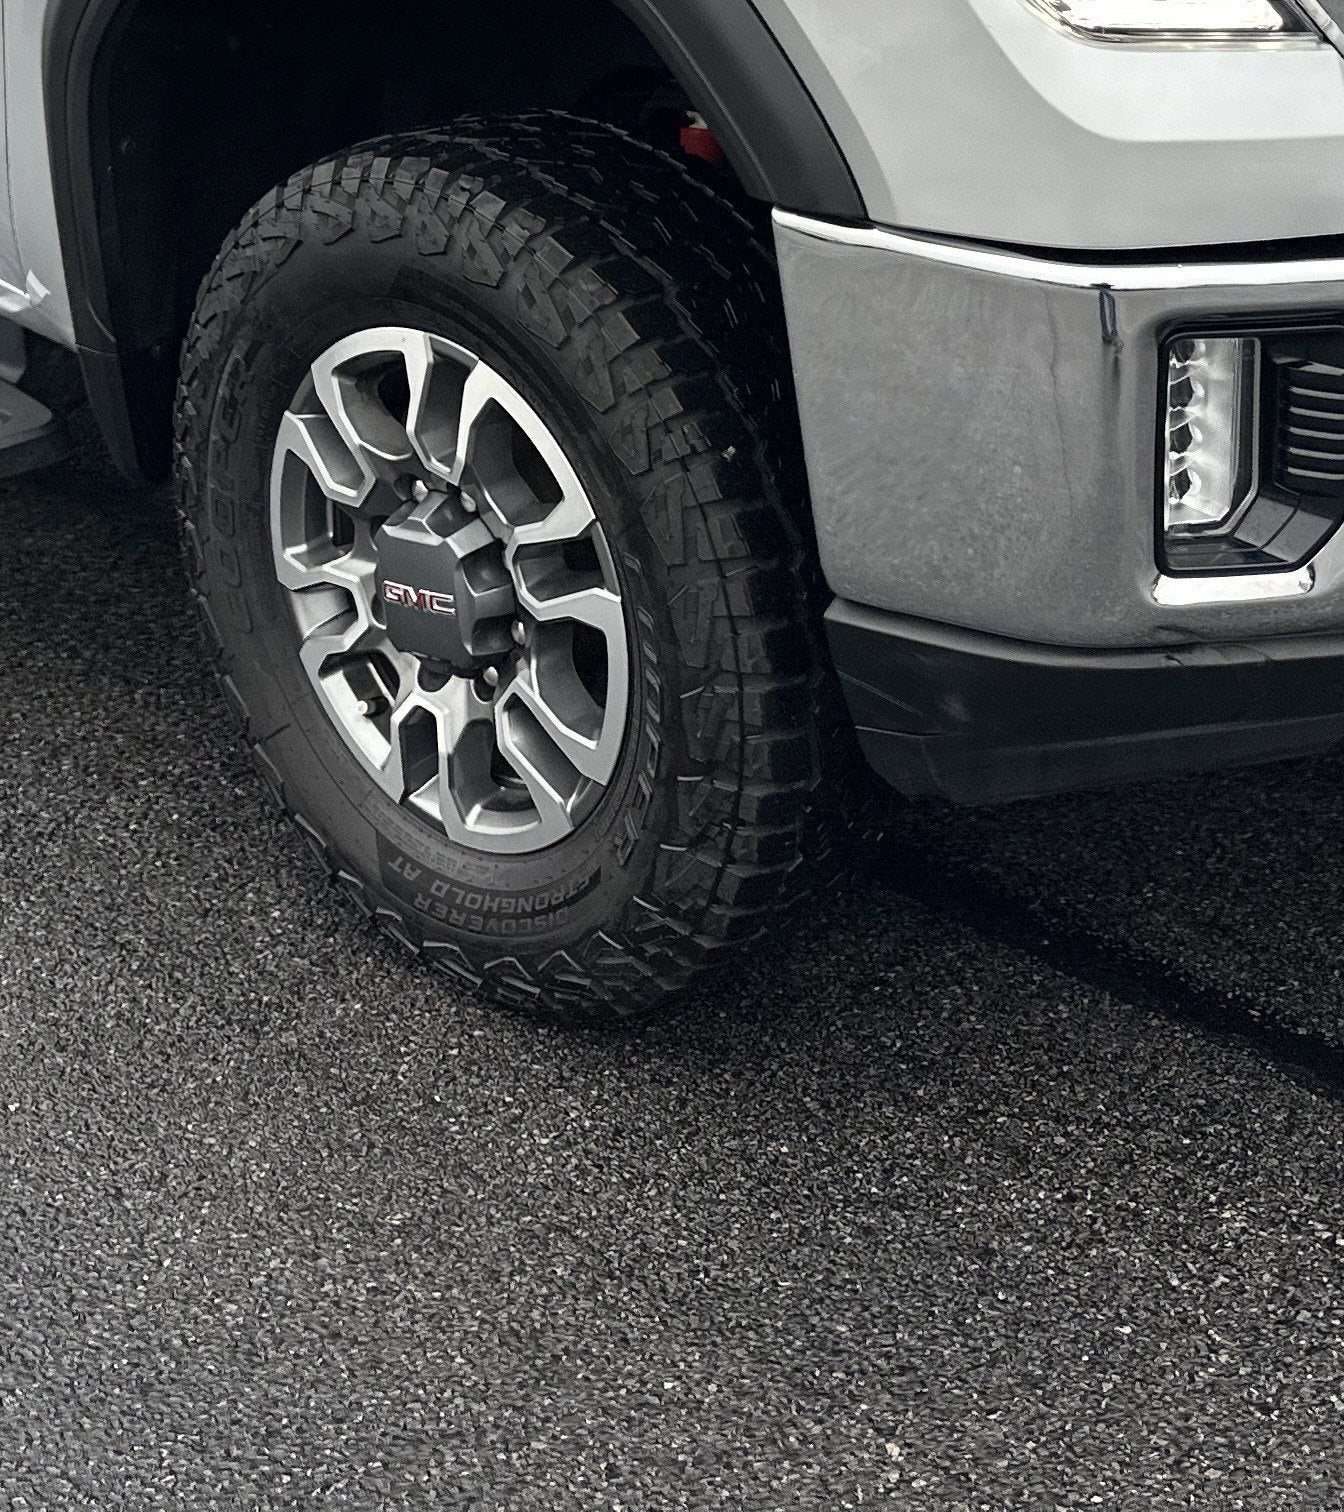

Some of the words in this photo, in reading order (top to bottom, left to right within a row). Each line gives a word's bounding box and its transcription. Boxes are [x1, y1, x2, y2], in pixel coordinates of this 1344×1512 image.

[382, 579, 457, 617] GMC
[387, 856, 422, 882] AT
[413, 892, 568, 936] DISCOVERER
[429, 877, 590, 914] STRONGHOLD
